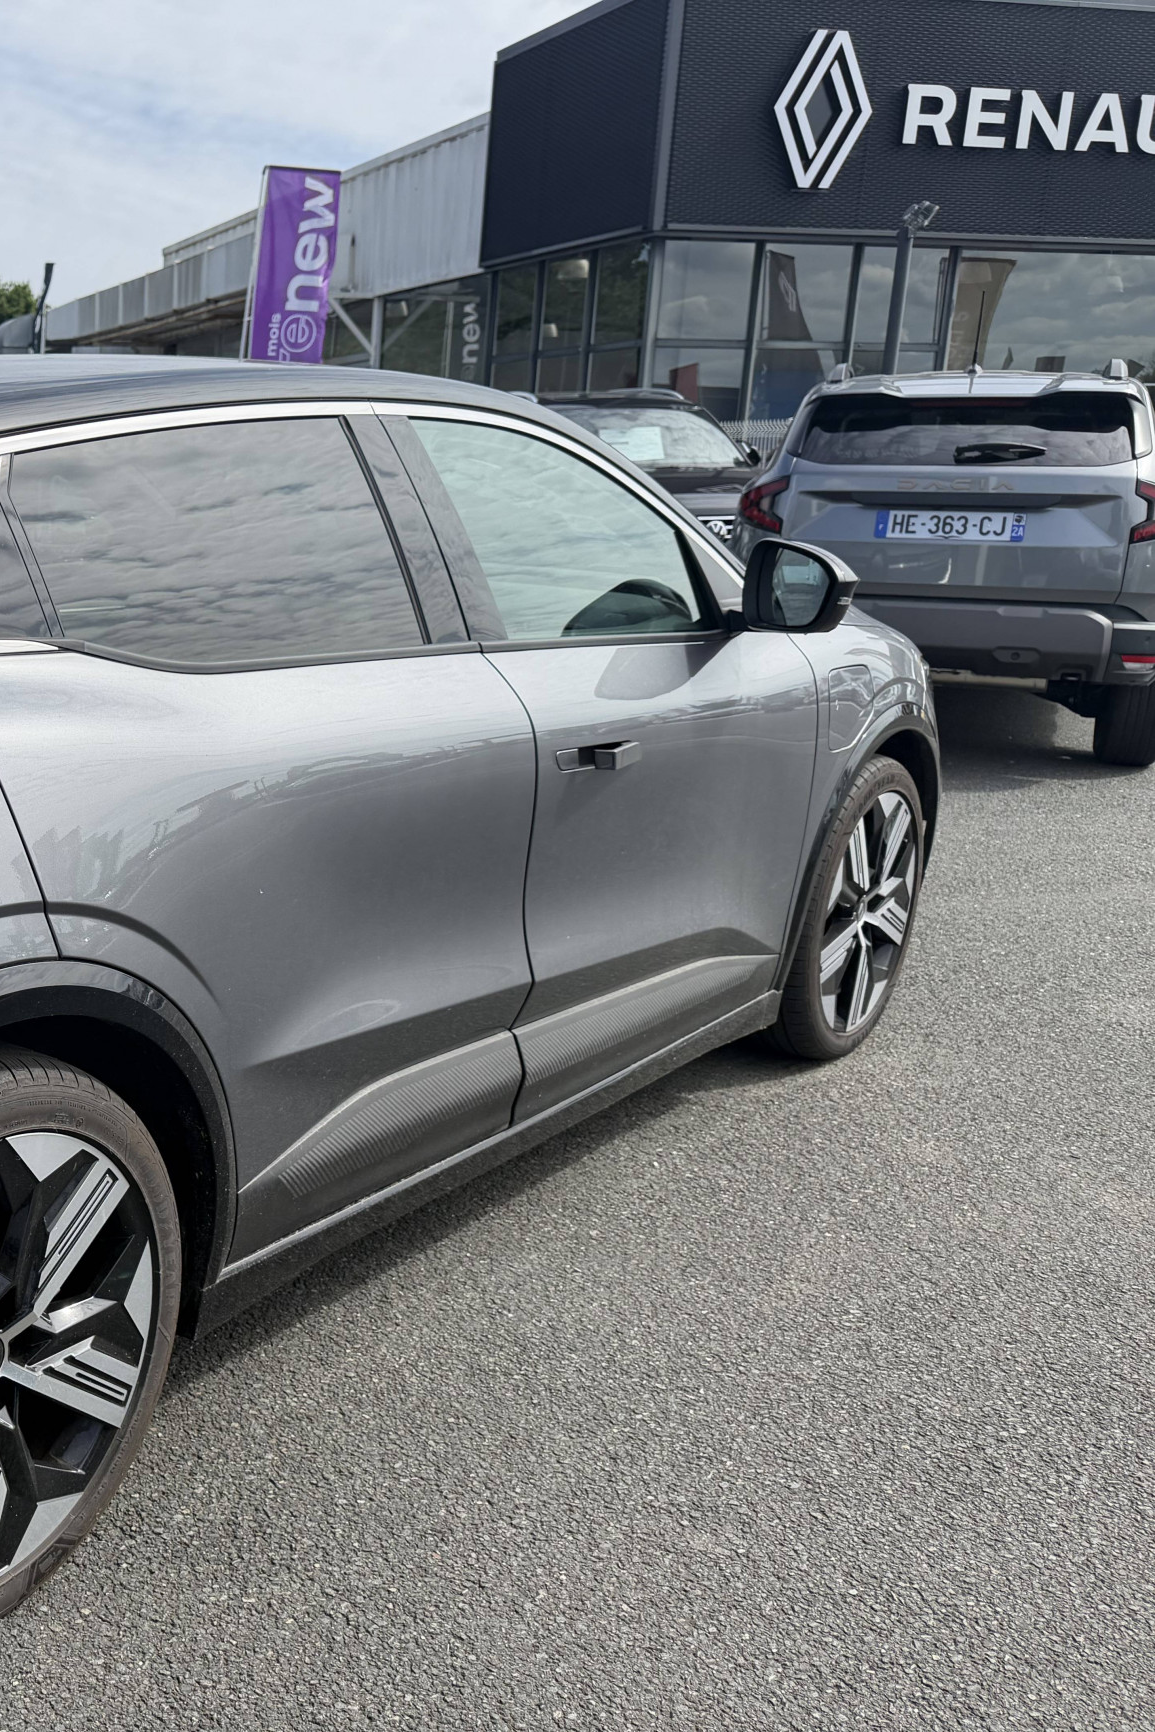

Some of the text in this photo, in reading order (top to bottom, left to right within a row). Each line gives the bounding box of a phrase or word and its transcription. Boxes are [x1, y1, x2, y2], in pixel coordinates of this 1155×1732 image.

[267, 312, 282, 357] mois
[897, 478, 1014, 491] DACIA
[891, 513, 1007, 537] HE-363-CJ
[1011, 526, 1024, 537] 2A
